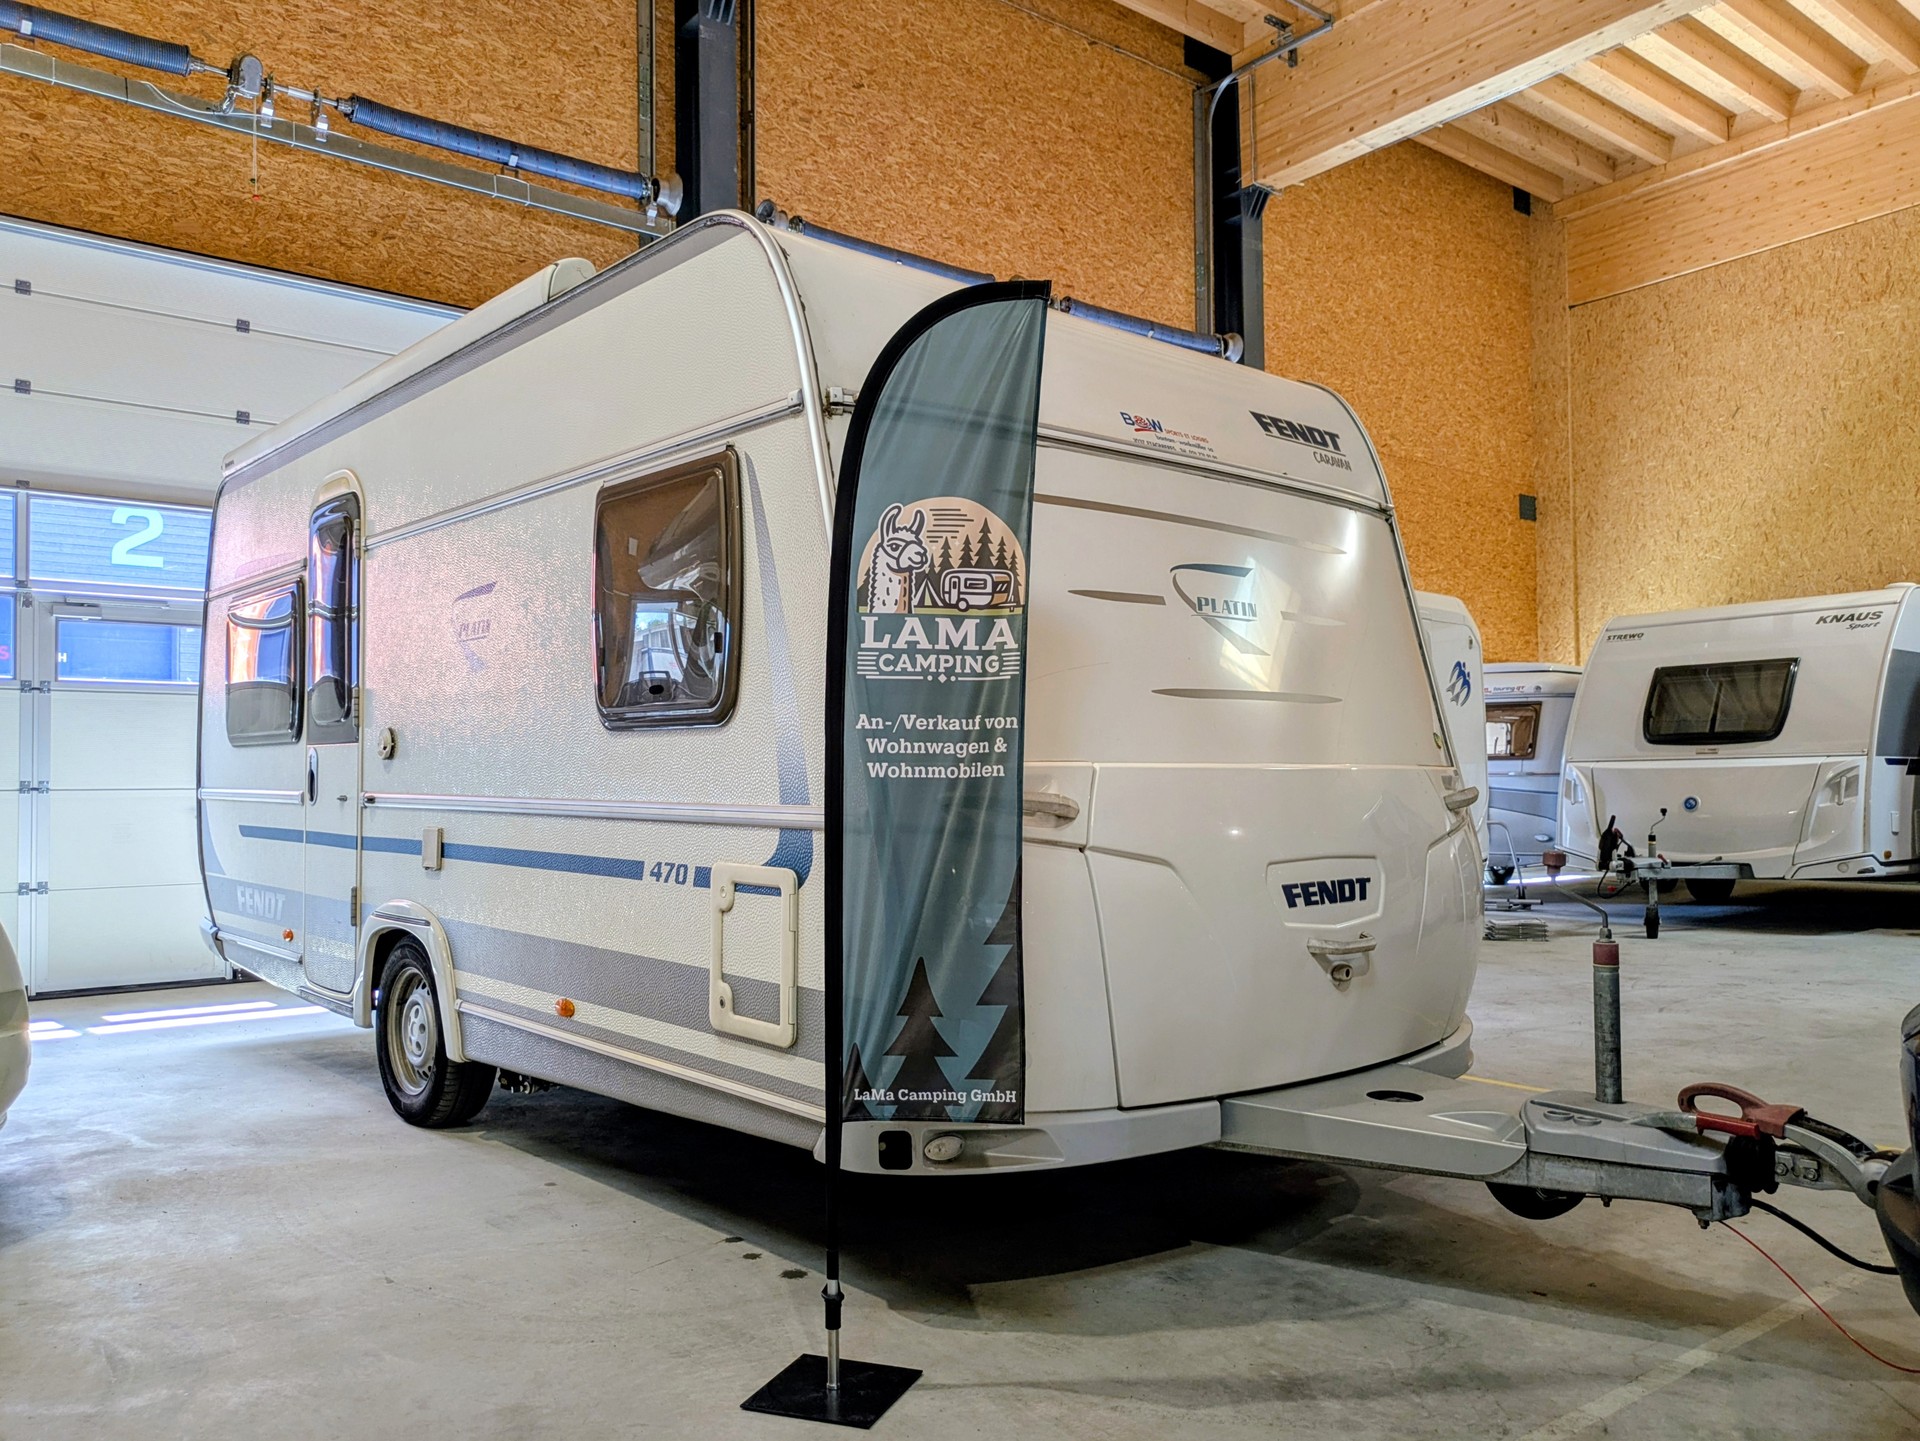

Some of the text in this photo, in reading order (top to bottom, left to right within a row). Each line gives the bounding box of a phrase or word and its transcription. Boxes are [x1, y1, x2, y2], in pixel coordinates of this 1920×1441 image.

[1249, 410, 1341, 452] FENDT
[1313, 451, 1352, 472] CARAVAN
[112, 507, 163, 568] 2
[1197, 596, 1257, 617] PLATIN
[1815, 611, 1883, 624] KNAUS
[860, 616, 1018, 650] LAMA
[1607, 632, 1644, 641] STREWO
[878, 654, 1000, 673] CAMPING
[855, 714, 1018, 733] An-/Verkauf von
[866, 737, 1007, 758] Wohnwagen &
[867, 762, 1005, 778] Wohnmobilen
[650, 861, 688, 885] 470
[236, 885, 286, 920] FENDT
[1281, 877, 1371, 909] FENDT
[854, 1088, 1016, 1104] LaMa Camping GmbH
